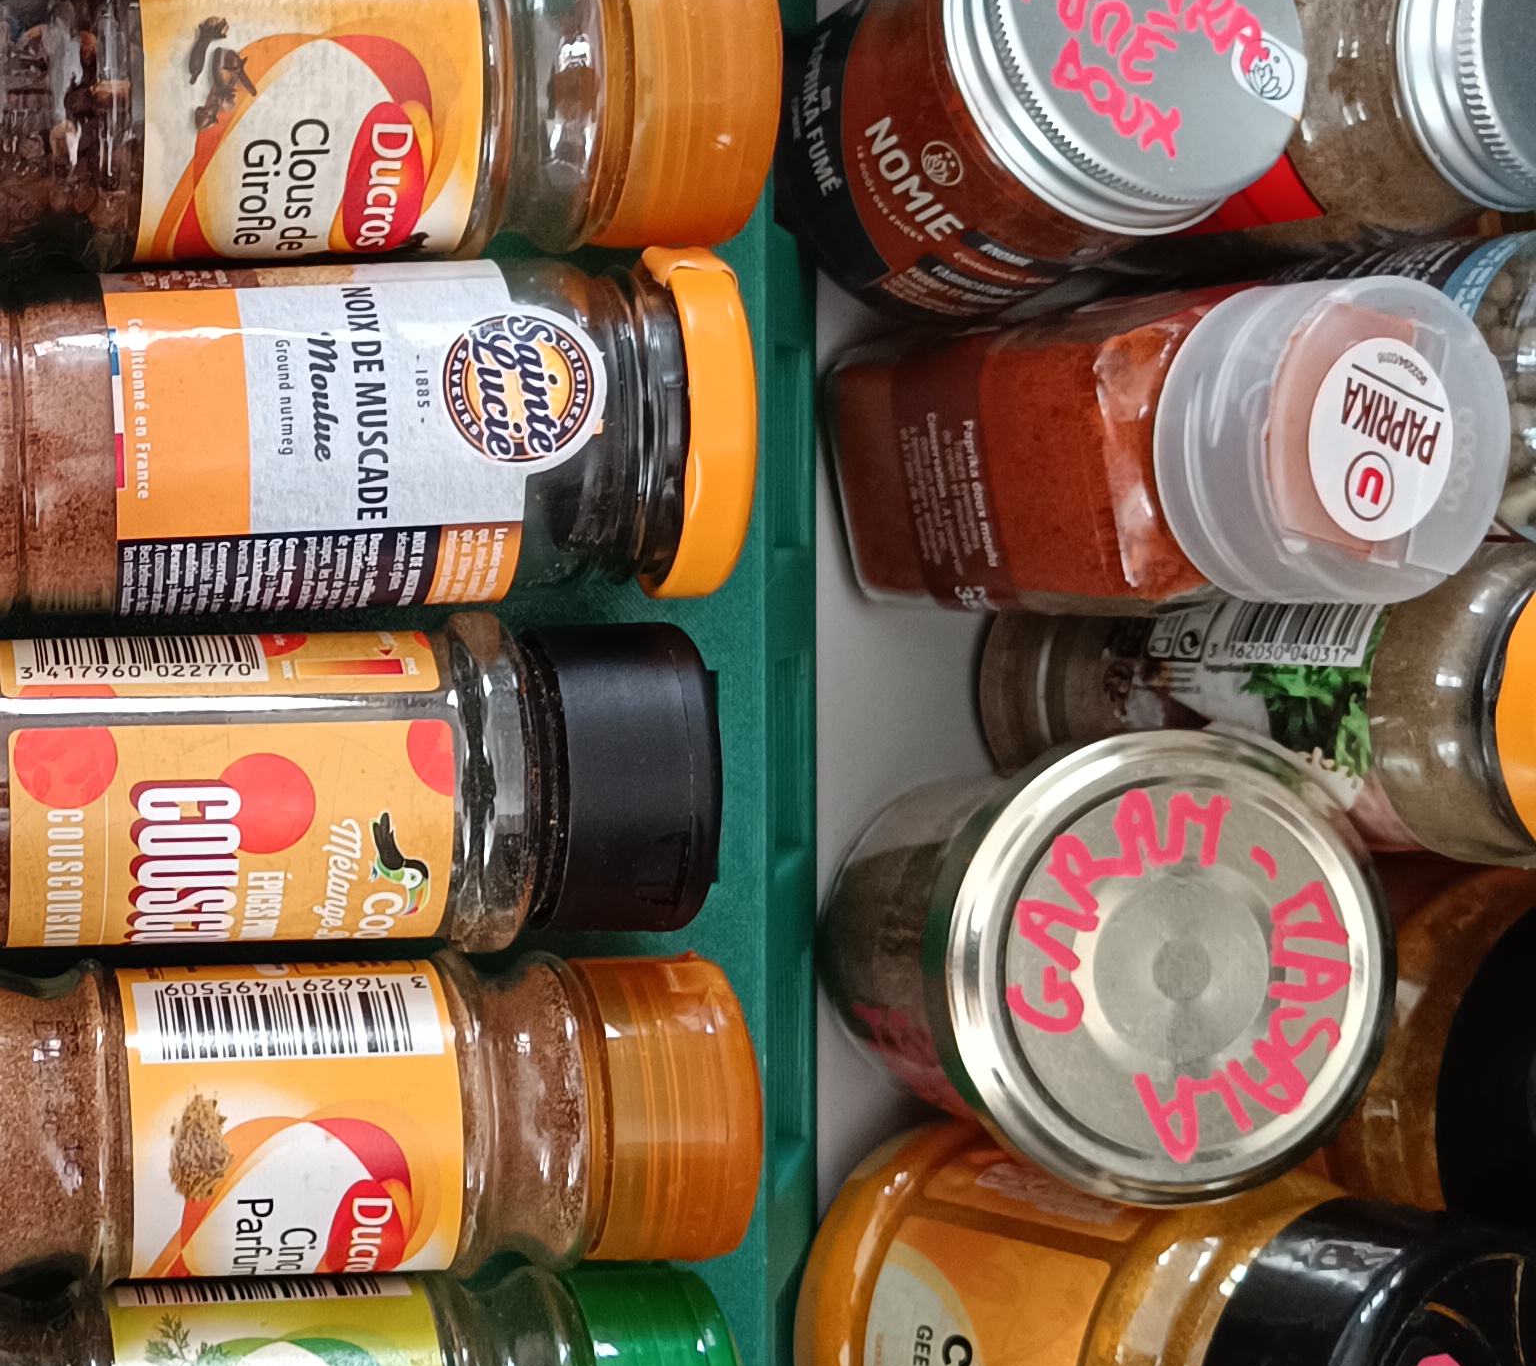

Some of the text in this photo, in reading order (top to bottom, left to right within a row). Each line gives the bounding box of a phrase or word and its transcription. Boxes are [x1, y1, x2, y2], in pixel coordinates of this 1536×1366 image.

[232, 139, 282, 246] Girofle
[276, 118, 331, 251] Clous de
[355, 122, 414, 247] Ducros
[805, 126, 842, 197] FUMÉ
[864, 116, 965, 244] NOMIE
[133, 416, 149, 437] en
[274, 340, 296, 456] Ground nutmeg
[307, 332, 340, 462] Moulue
[340, 286, 390, 521] NOIX DE MUSCADE
[415, 369, 430, 409] 1885
[451, 348, 481, 436] SAVEURS
[471, 333, 519, 459] Lucie
[512, 319, 561, 456] Sainte
[559, 340, 587, 430] ORIGINES
[1337, 376, 1443, 466] PAPRIKA
[134, 442, 152, 499] France
[129, 782, 242, 943] COUSCO
[246, 871, 292, 917] ÉPICES
[313, 818, 363, 927] Mélange
[230, 1198, 274, 1275] Parfu
[343, 1197, 393, 1272] Ducr
